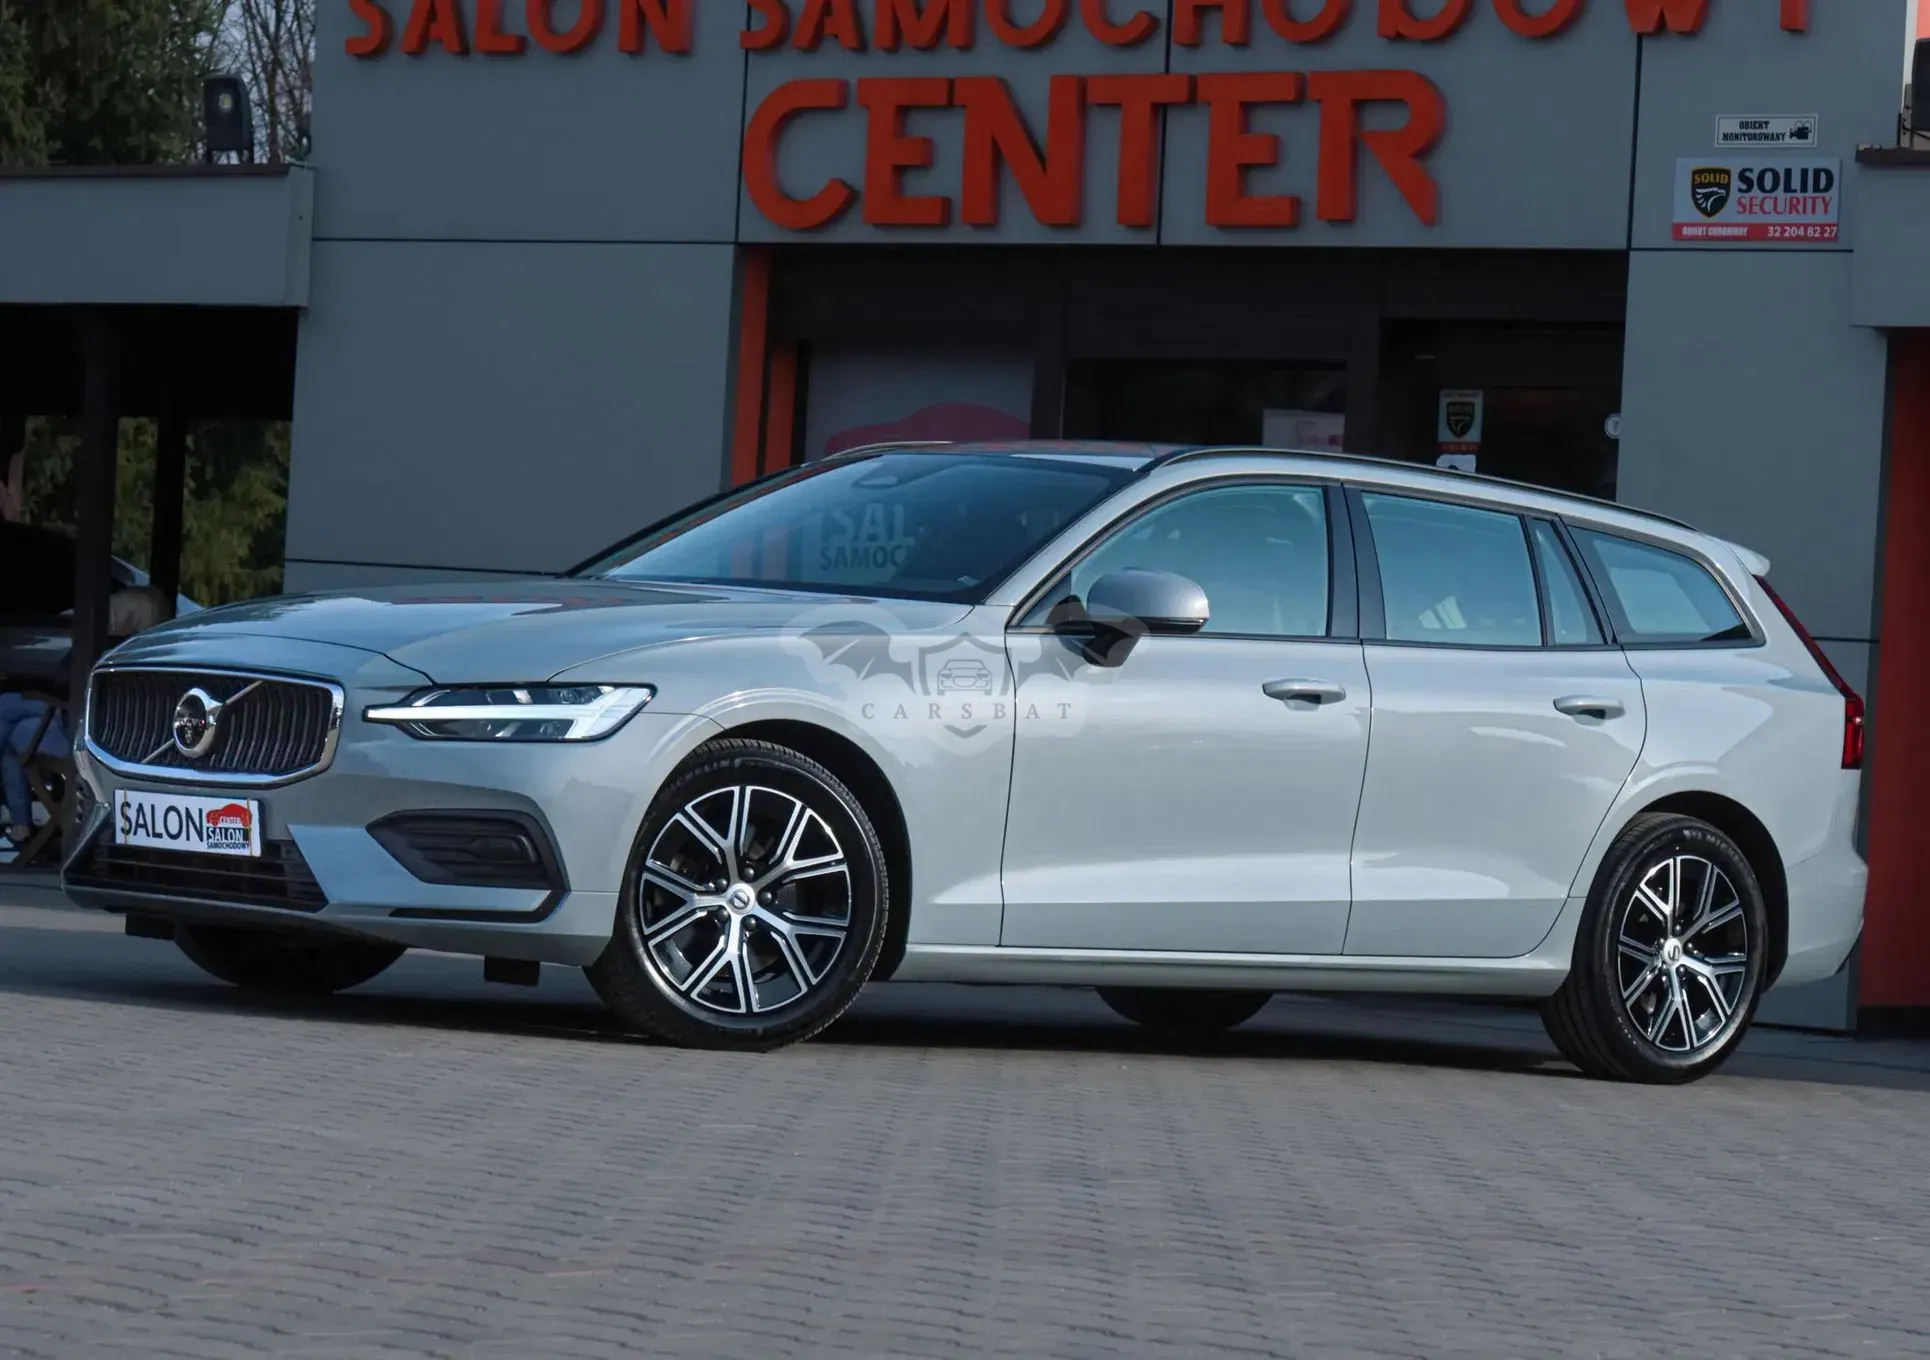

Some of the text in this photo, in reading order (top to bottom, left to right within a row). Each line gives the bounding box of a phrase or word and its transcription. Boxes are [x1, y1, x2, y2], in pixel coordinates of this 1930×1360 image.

[344, 0, 695, 55] SALON
[1739, 120, 1770, 130] OBIEKT
[1722, 132, 1786, 142] MONITOROWANY
[742, 71, 1447, 230] CENTER
[1693, 172, 1729, 186] SOLID
[1737, 168, 1834, 194] SOLID
[1736, 196, 1833, 216] SECURITY
[1767, 226, 1837, 237] 32 204 82 27
[120, 801, 204, 843] SALON
[207, 827, 244, 842] SALON
[206, 840, 250, 851] SAMOCHODOWY
